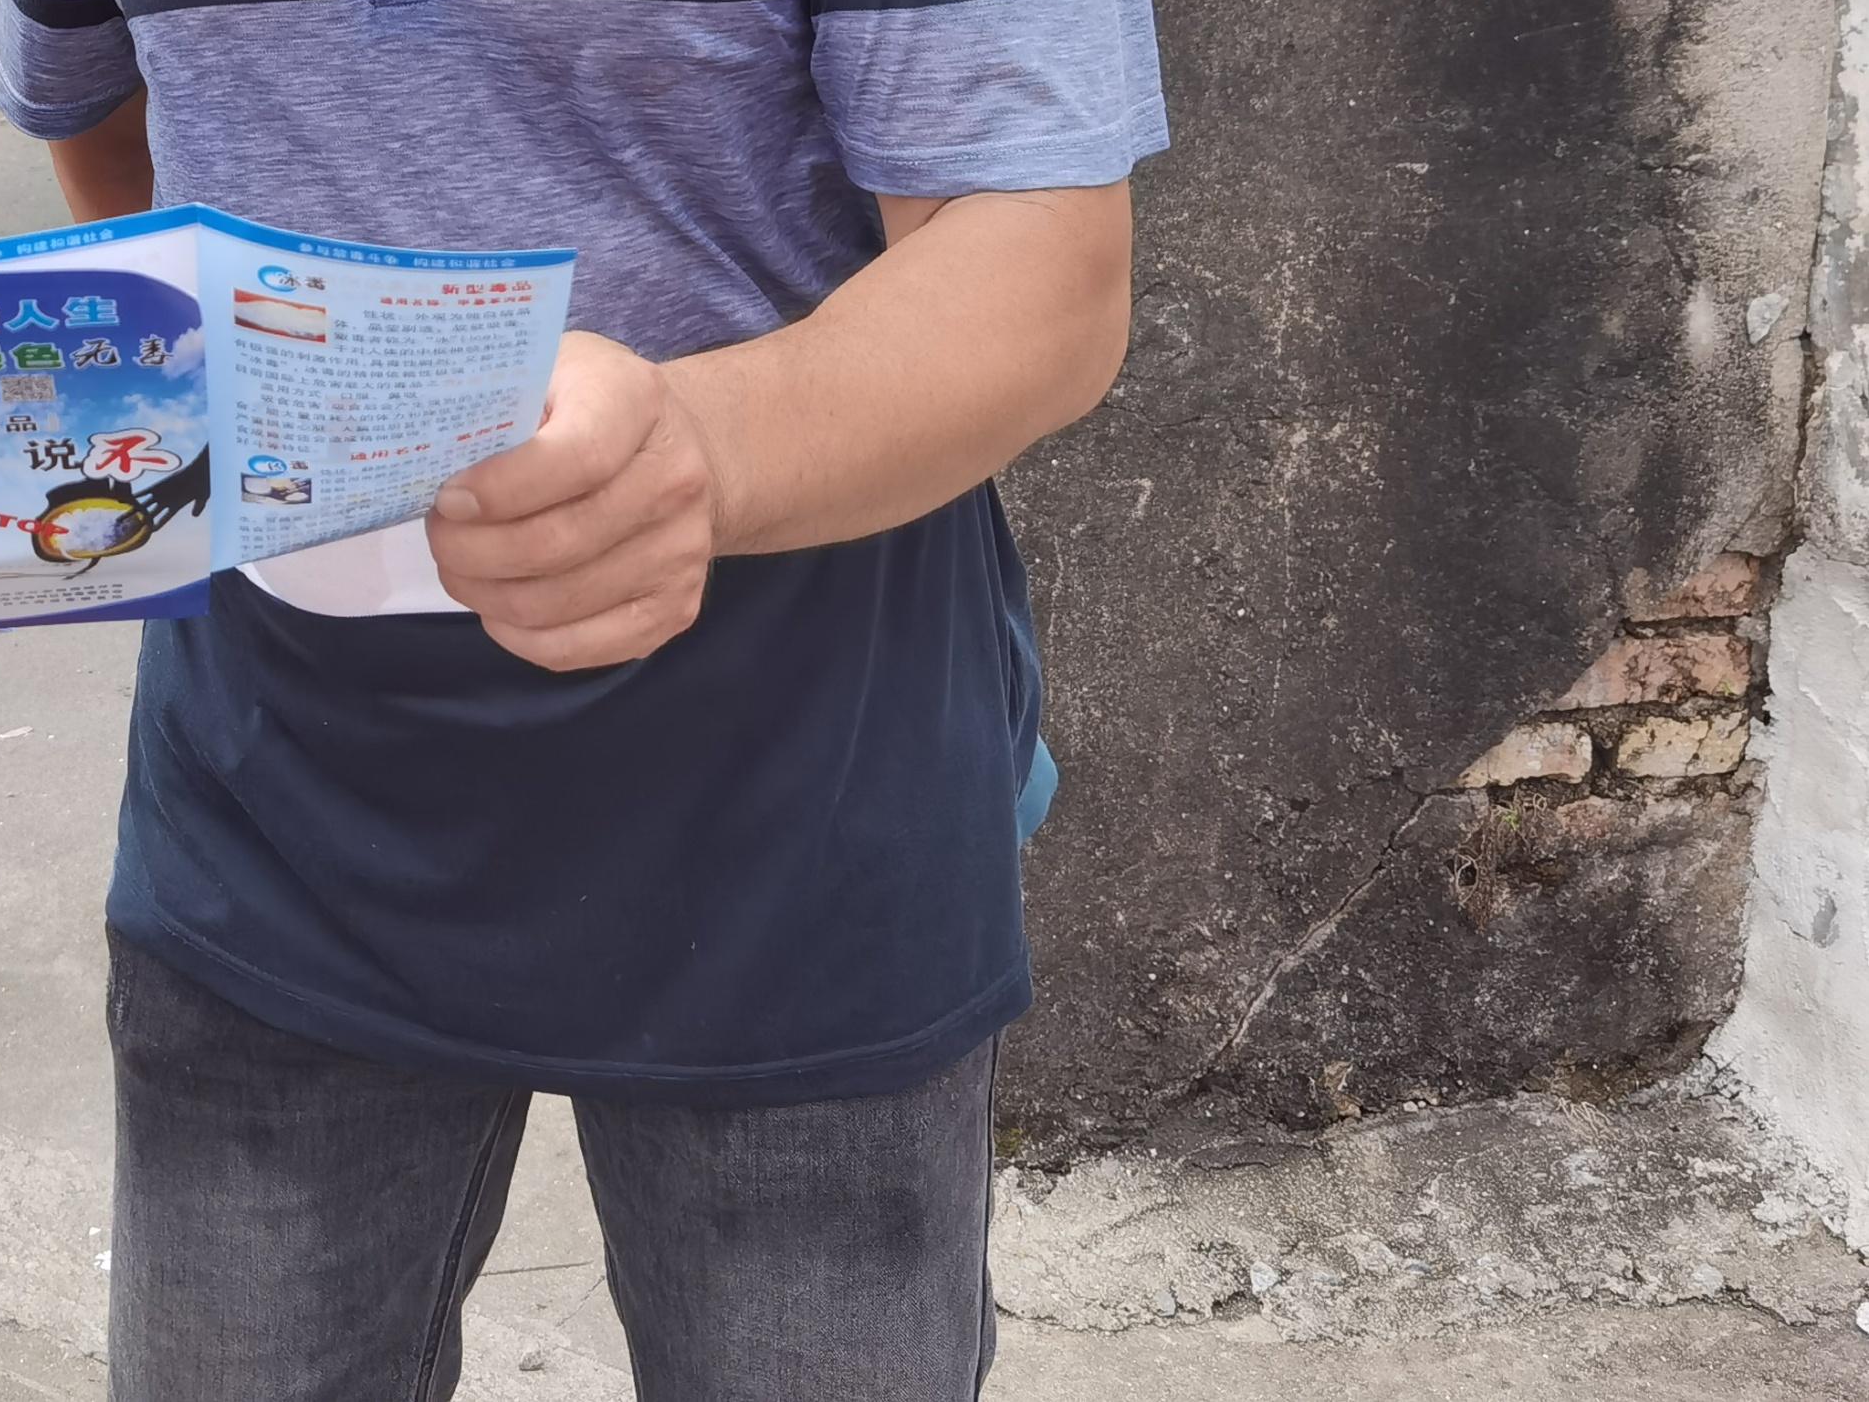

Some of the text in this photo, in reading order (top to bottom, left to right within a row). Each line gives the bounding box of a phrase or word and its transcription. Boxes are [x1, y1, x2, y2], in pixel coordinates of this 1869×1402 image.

[15, 227, 115, 256] 构建和谐社会
[23, 433, 169, 474] 说不
